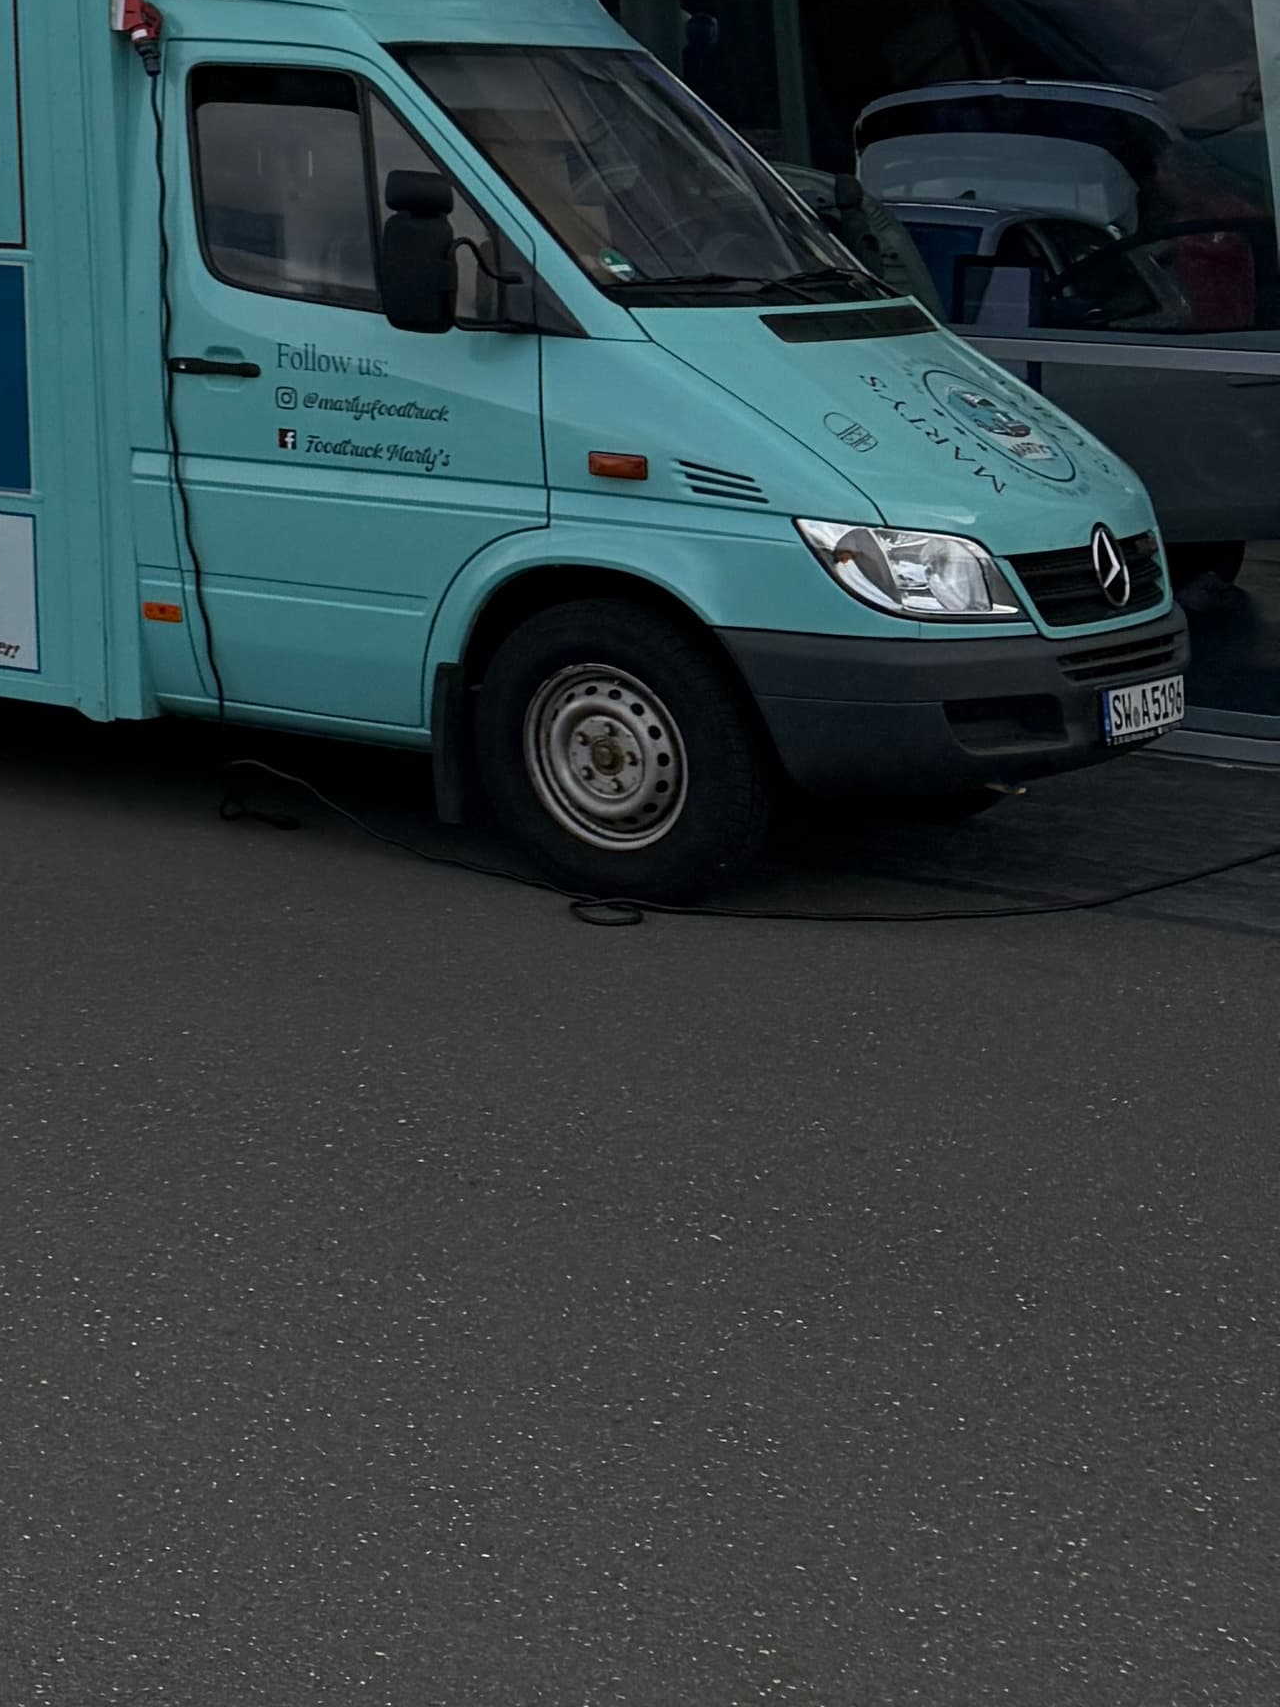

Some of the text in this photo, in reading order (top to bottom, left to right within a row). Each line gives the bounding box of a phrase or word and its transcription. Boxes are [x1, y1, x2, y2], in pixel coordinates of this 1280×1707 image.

[276, 342, 389, 377] Follow us:
[303, 392, 449, 422] @martysfoodtruck
[305, 434, 383, 460] Foodtruck
[386, 443, 452, 472] Marty's
[860, 374, 1007, 495] MARTY'S
[1142, 688, 1151, 725] A
[1151, 679, 1182, 721] 5196
